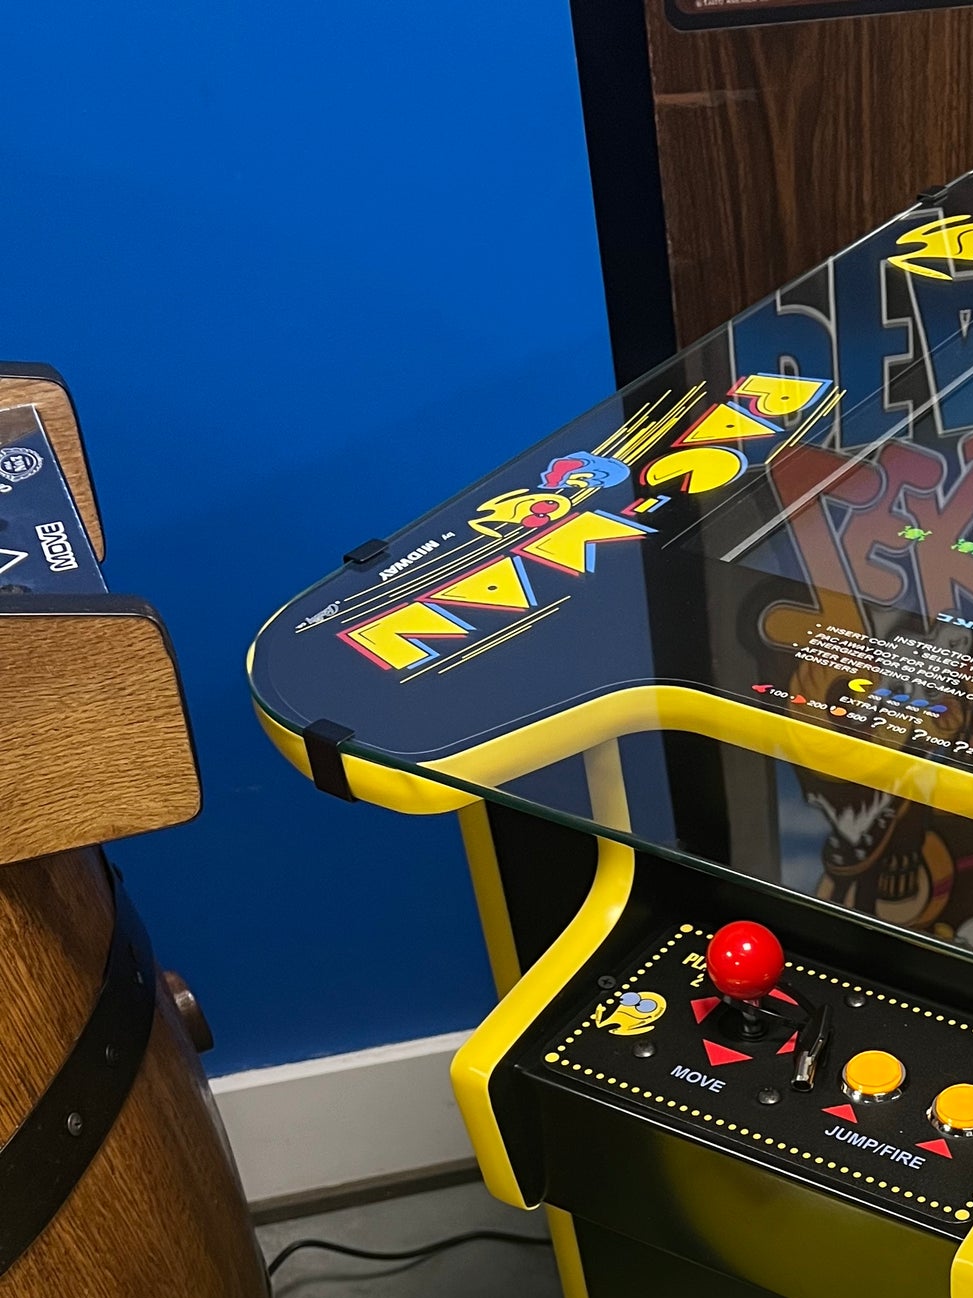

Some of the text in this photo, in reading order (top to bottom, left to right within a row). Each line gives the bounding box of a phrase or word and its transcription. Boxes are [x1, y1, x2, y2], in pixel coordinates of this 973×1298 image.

[335, 372, 840, 671] PAC-MAN
[36, 521, 78, 572] MOVE
[378, 539, 440, 581] MIDWAY
[815, 632, 840, 643] PAC
[839, 639, 875, 653] AWAY
[873, 649, 901, 660] DOT
[899, 656, 925, 668] FOR
[826, 625, 899, 650] INSERT COIN
[794, 652, 859, 674] MONSTERS
[800, 646, 840, 661] AFTER
[840, 658, 911, 681] ENERGIZING
[911, 678, 966, 698] PAC-MAN
[808, 638, 875, 661] ENERGIZER
[874, 657, 901, 669] FOR
[916, 669, 961, 686] POINTS
[921, 652, 967, 669] SELECT
[769, 688, 789, 698] 100
[846, 712, 868, 723] 500
[886, 723, 907, 734] 700
[926, 735, 951, 748] 1000
[839, 695, 924, 725] EXTRA POINTS
[690, 973, 705, 988] 2
[670, 1063, 726, 1094] MOVE
[823, 1124, 927, 1172] JUMP/FIRE
